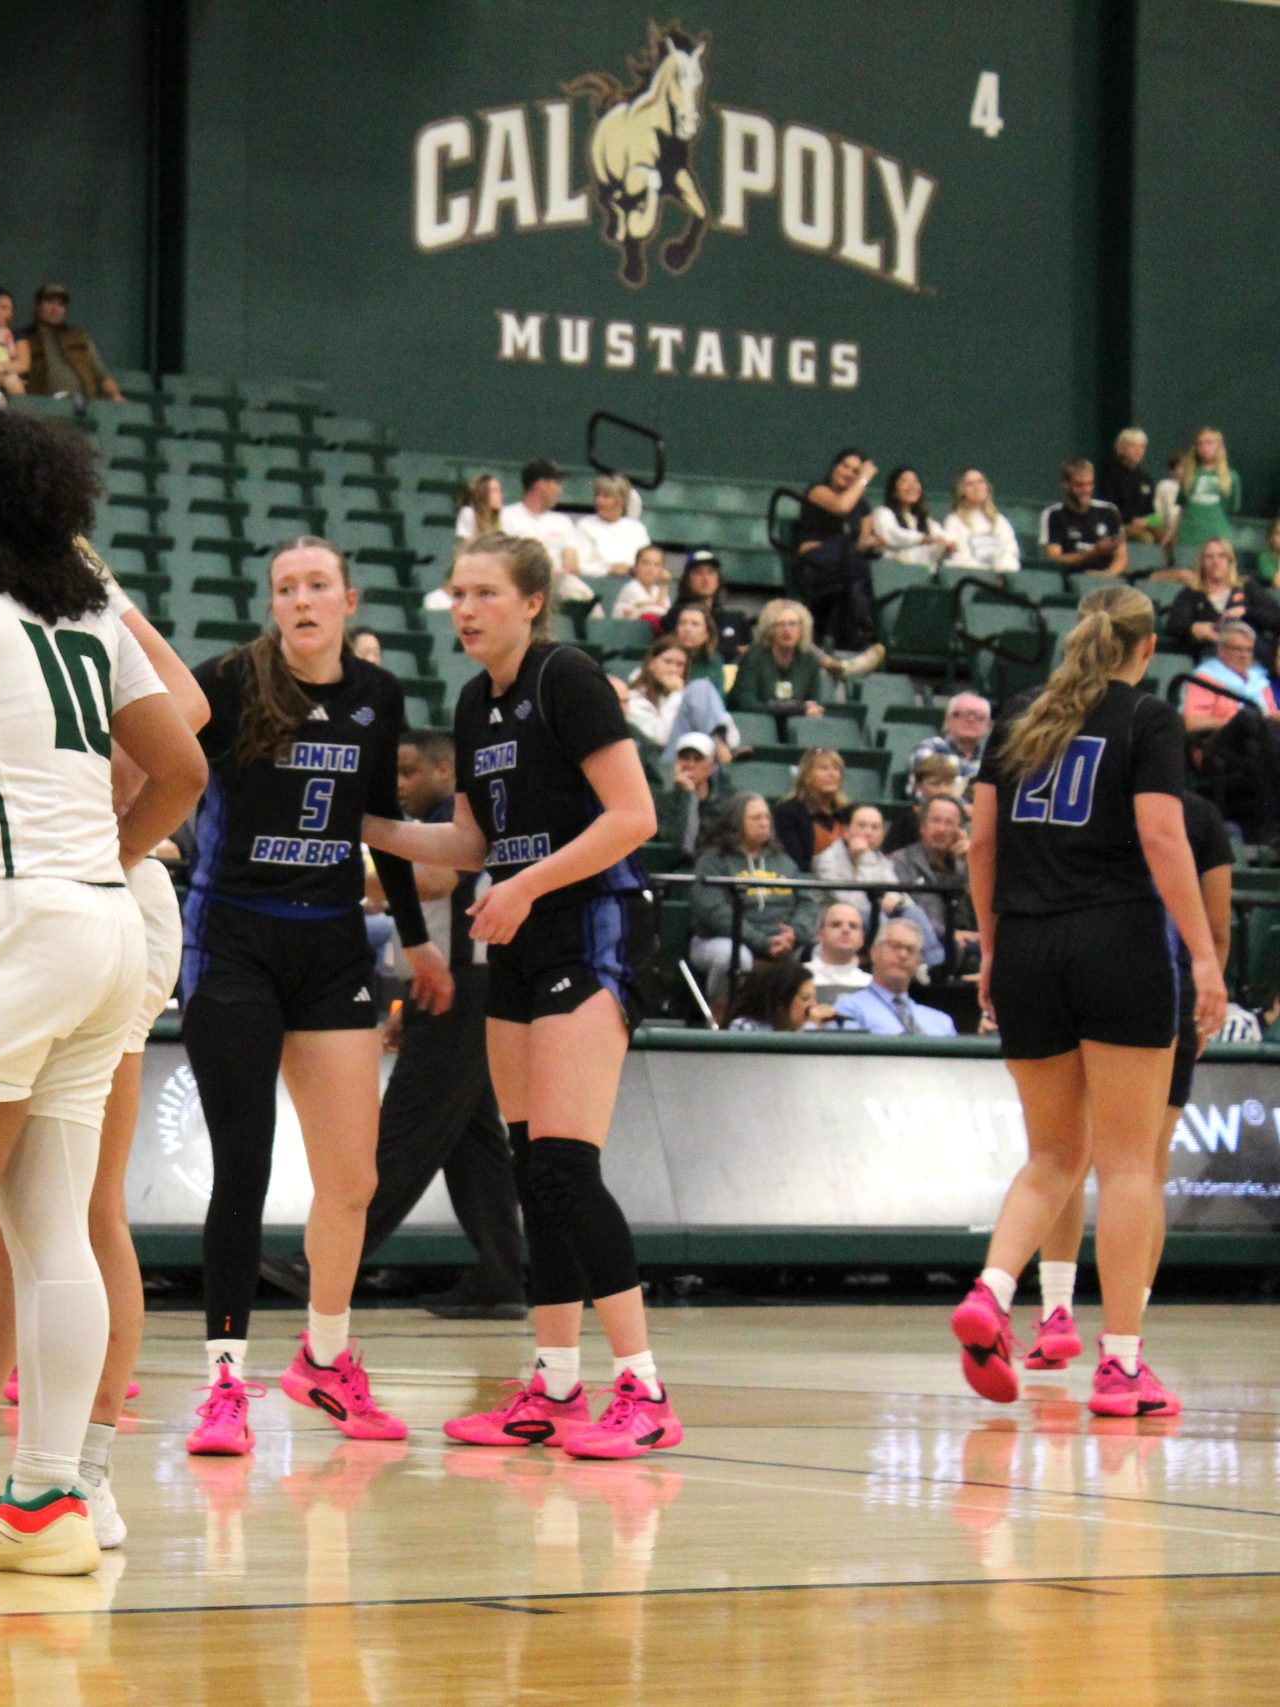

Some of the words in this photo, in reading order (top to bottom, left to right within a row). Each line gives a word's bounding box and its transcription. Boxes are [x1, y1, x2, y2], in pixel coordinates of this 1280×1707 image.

[970, 71, 1004, 137] 4
[414, 101, 590, 252] CAL
[718, 107, 937, 291] POLY
[497, 309, 860, 389] MUSTANGS
[19, 618, 113, 763] 10
[473, 740, 518, 778] SANTA
[1010, 735, 1107, 827] 20
[298, 777, 336, 832] 5
[489, 778, 508, 833] 2
[250, 835, 353, 867] BARBAR
[484, 832, 551, 867] BARA
[863, 1097, 1026, 1154] WHIT
